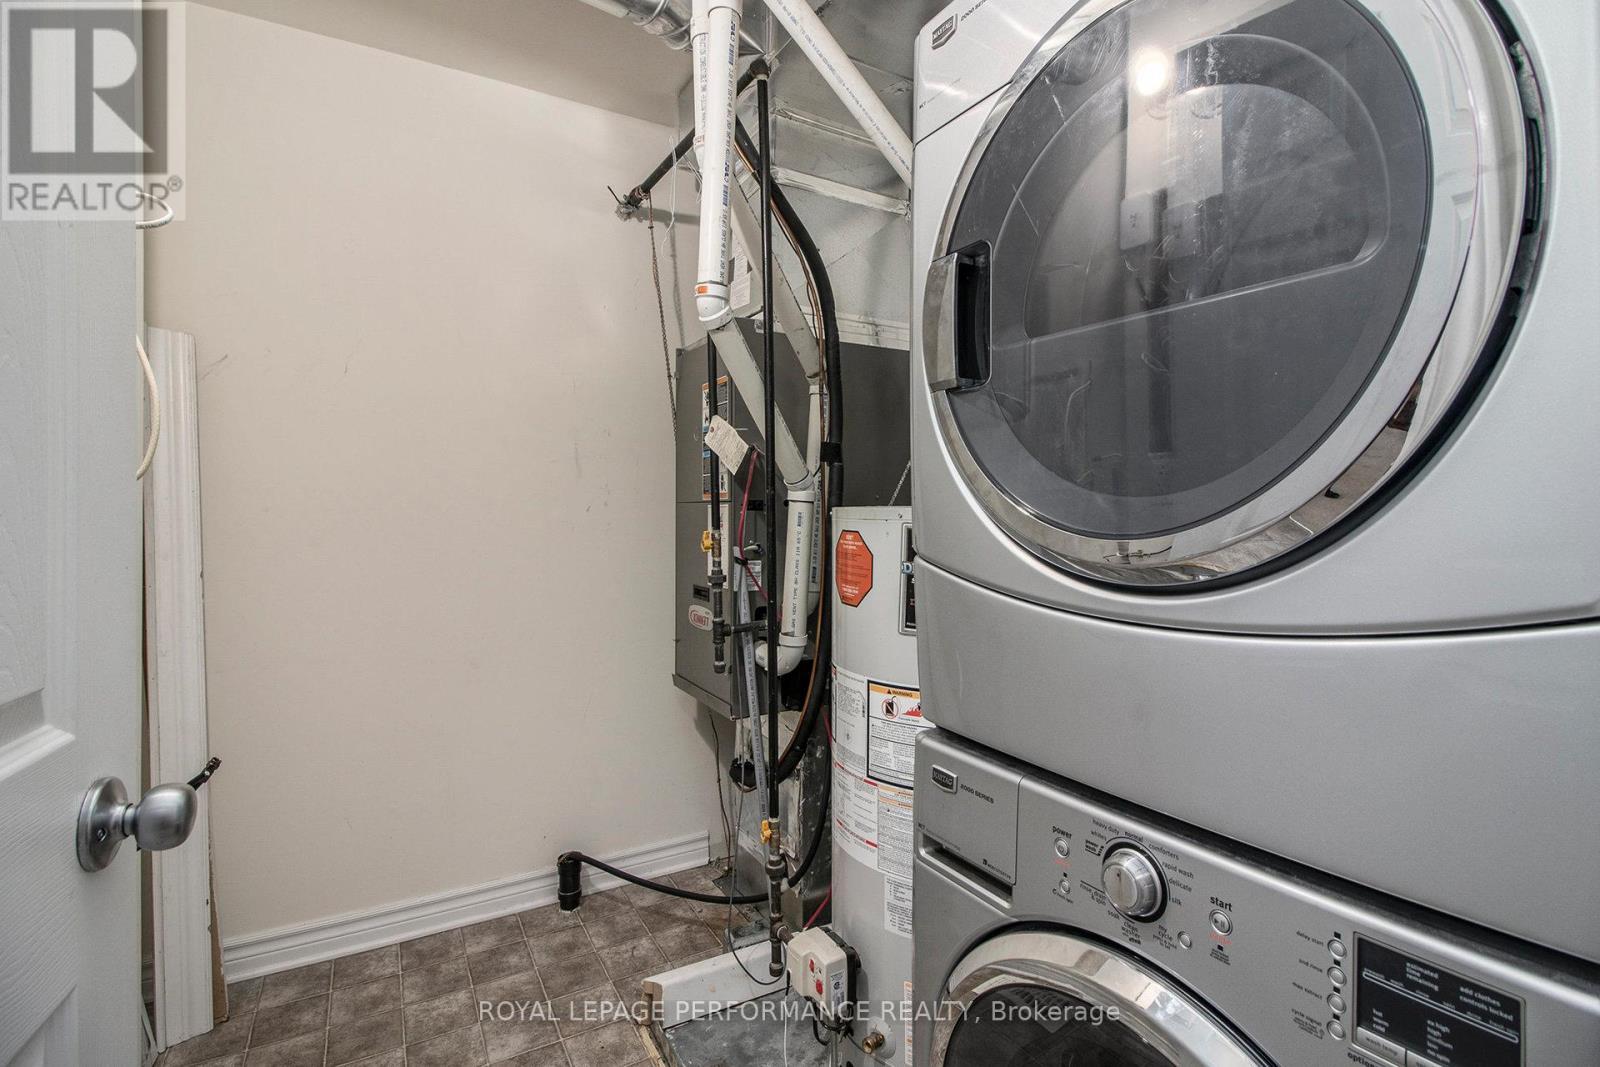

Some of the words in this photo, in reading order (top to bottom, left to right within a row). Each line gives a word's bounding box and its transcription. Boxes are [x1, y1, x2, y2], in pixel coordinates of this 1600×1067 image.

[891, 689, 913, 698] WARNING
[960, 783, 974, 794] 2000
[974, 790, 994, 804] SERIES
[1052, 826, 1072, 840] power
[1124, 831, 1144, 842] normal
[1148, 844, 1180, 860] comforters
[1162, 861, 1178, 872] rapid
[1178, 868, 1194, 878] wash
[1168, 878, 1192, 892] delicate
[1171, 896, 1182, 906] silk
[1210, 896, 1232, 912] start
[1158, 930, 1173, 942] cycle
[1406, 962, 1439, 978] estimated
[1406, 968, 1421, 977] time
[1406, 974, 1439, 992] remaining
[1459, 986, 1474, 997] add
[1474, 992, 1501, 1007] clothes
[1459, 995, 1488, 1011] controls
[1489, 1006, 1514, 1022] locked
